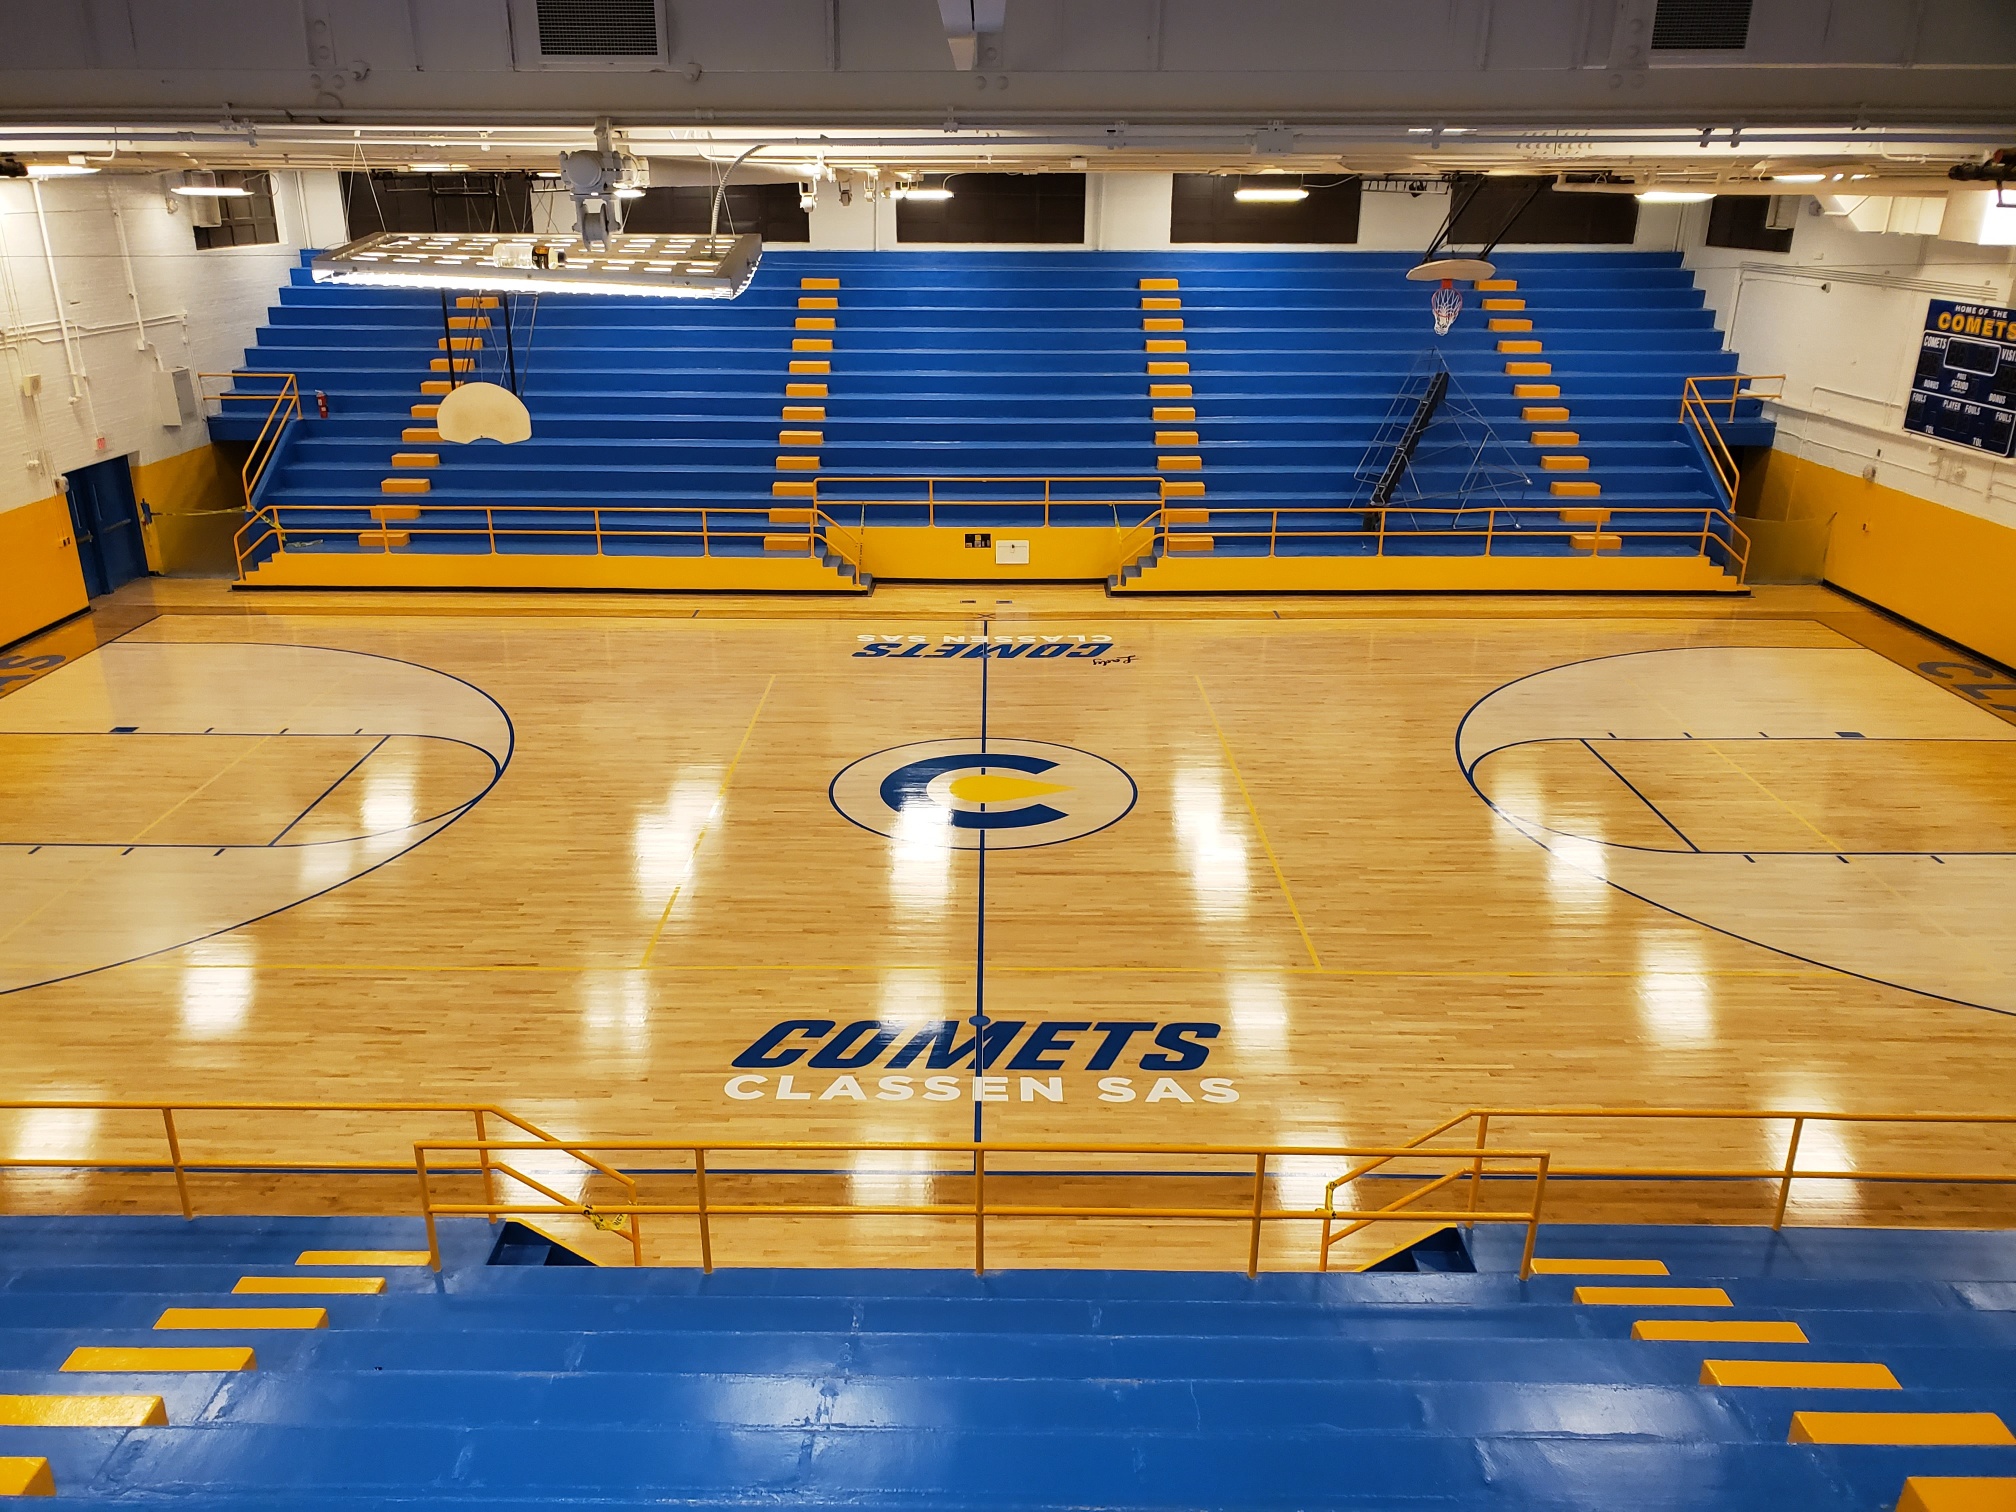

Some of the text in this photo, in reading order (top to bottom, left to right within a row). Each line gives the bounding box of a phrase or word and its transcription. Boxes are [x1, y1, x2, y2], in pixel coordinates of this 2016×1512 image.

[1955, 305, 2008, 319] HOME OF THE
[1938, 311, 2016, 340] COMETS
[1924, 335, 1947, 350] COMETS
[1923, 379, 1939, 390] BONUS
[1950, 379, 1969, 391] PERIOD
[1912, 392, 1927, 403] FOULS
[1988, 393, 2006, 405] BONUS
[1942, 399, 1981, 416] PLAYER FOULS
[1995, 411, 2013, 423] FOULS
[1972, 437, 1982, 447] TOL
[856, 634, 1113, 643] CLASSEN SAS
[851, 642, 1114, 659] COMETS
[731, 1019, 1222, 1071] COMETS
[724, 1073, 1241, 1104] CLASSEN SAS
